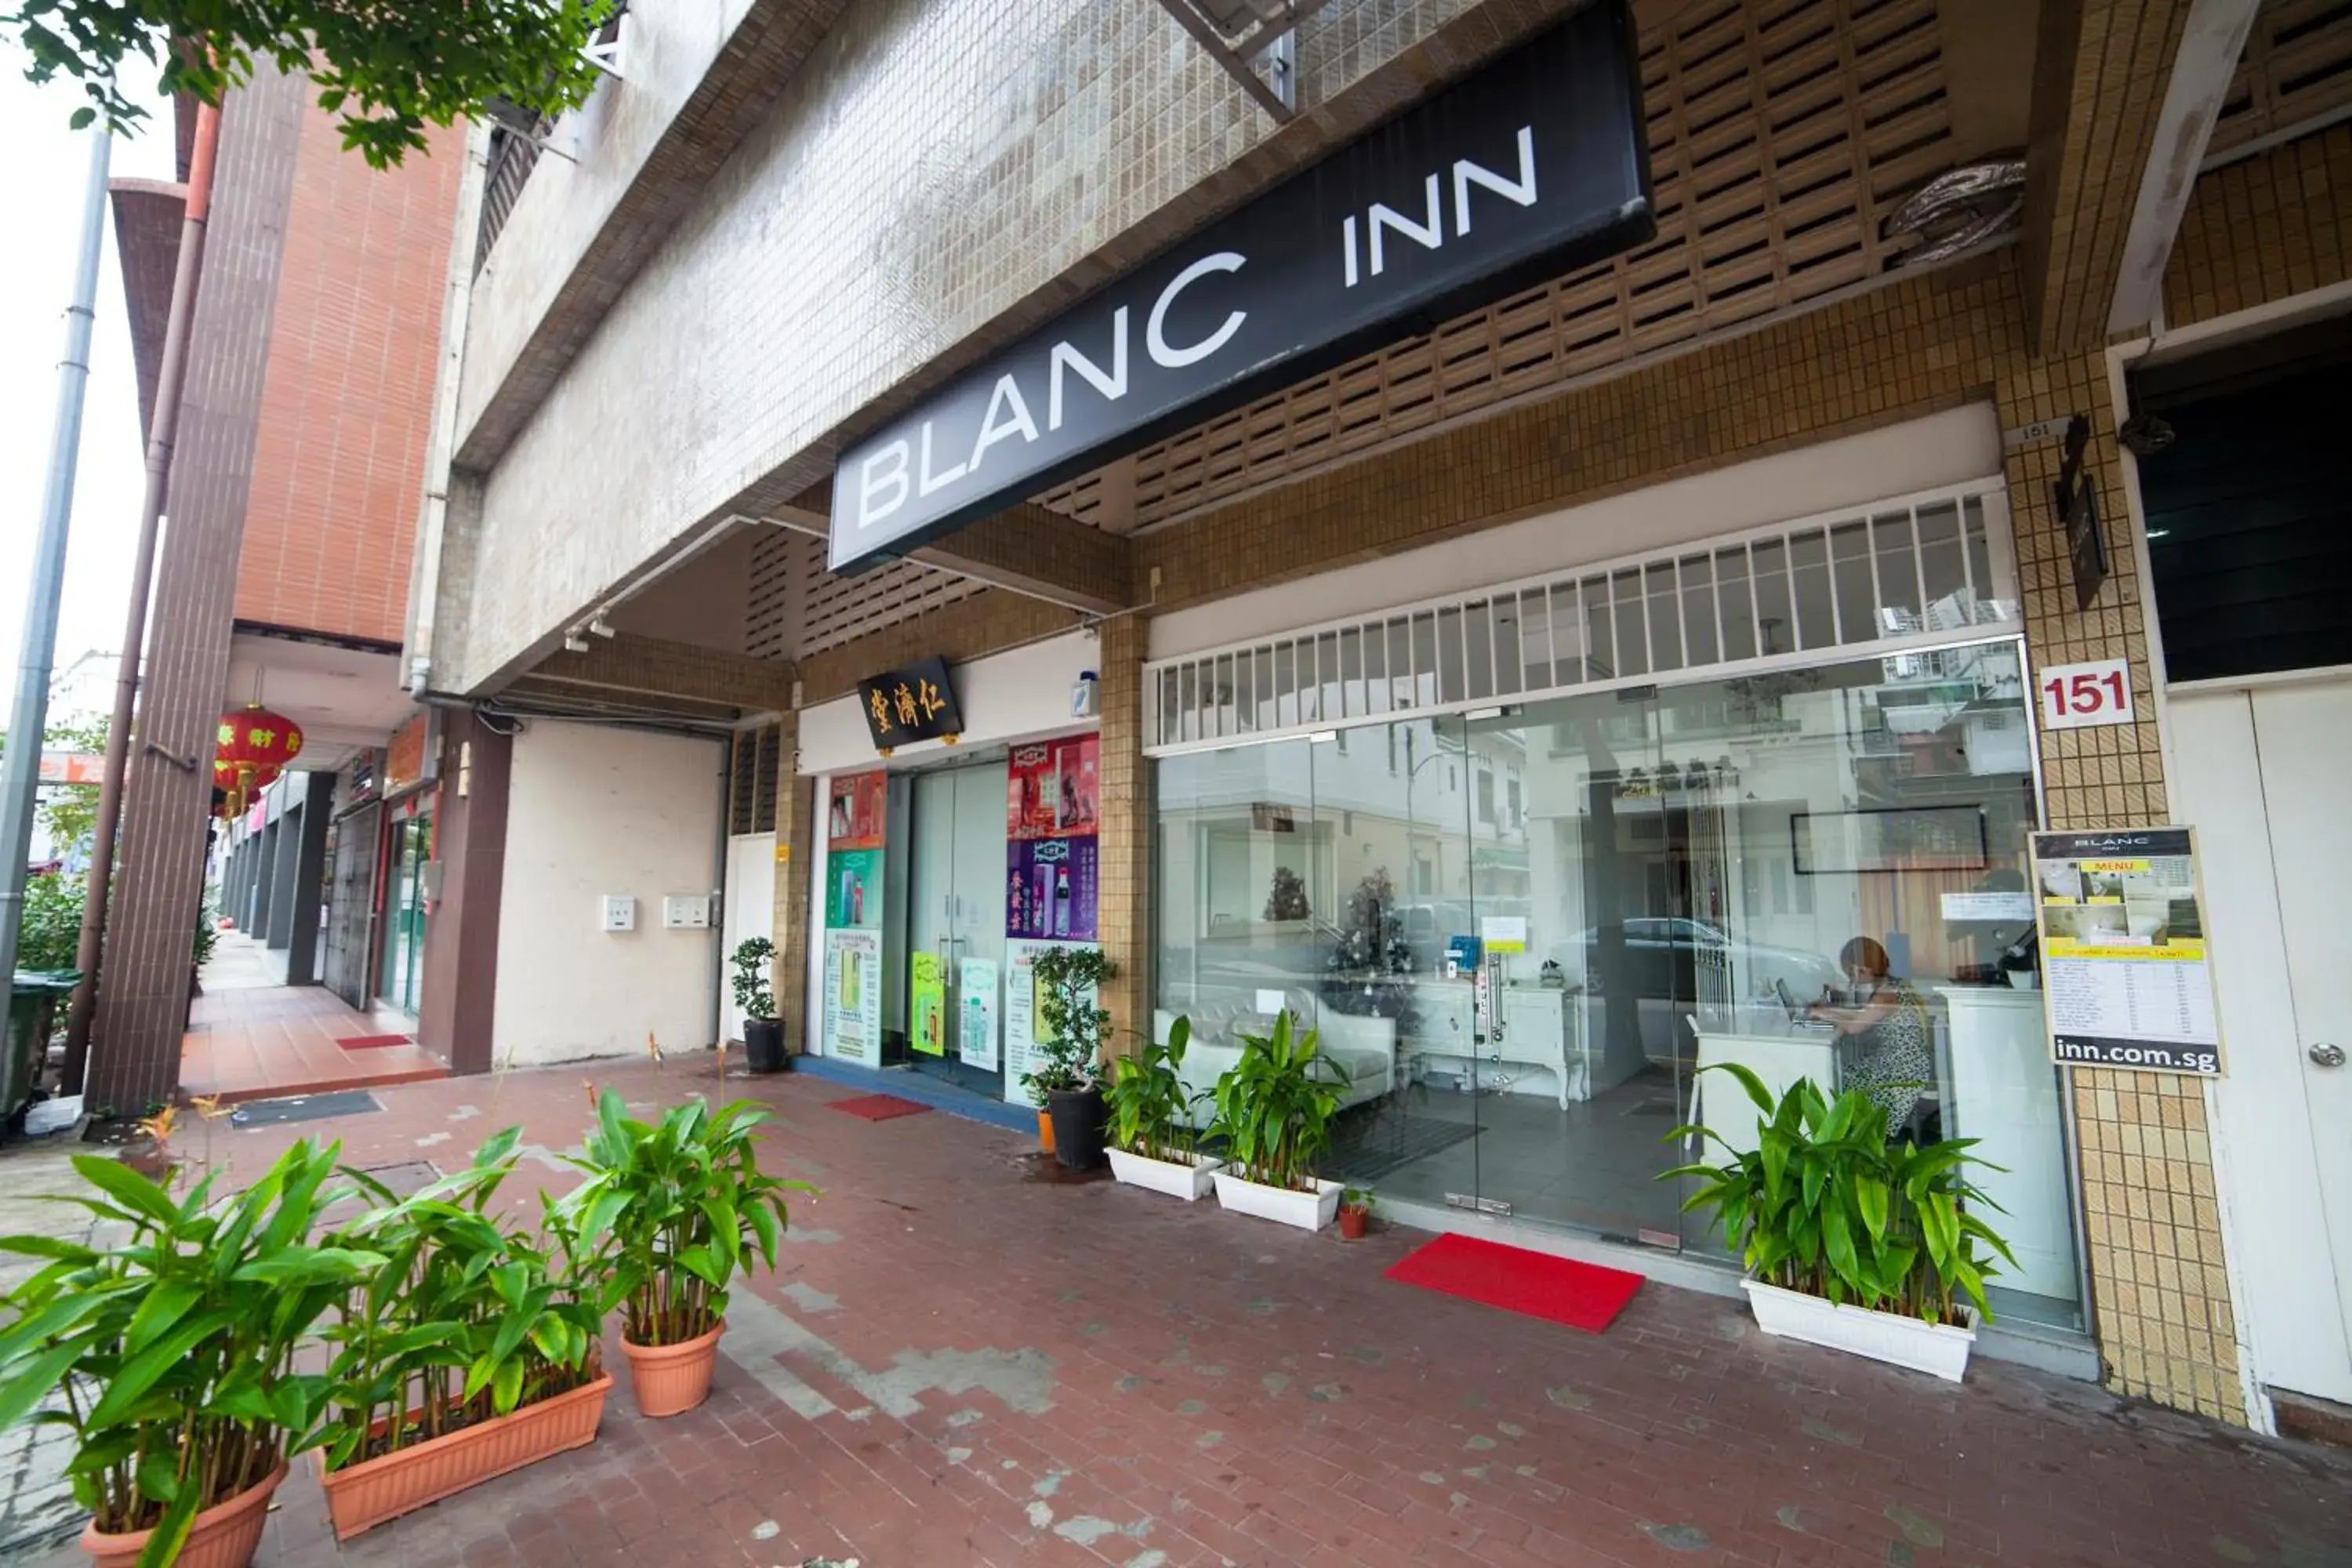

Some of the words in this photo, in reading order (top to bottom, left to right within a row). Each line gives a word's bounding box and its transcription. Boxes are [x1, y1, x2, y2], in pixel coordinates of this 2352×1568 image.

[857, 252, 1247, 530] BLANC
[1343, 125, 1537, 288] INN
[2024, 423, 2049, 439] 151
[2044, 670, 2125, 716] 151
[2074, 837, 2149, 848] BLANC
[2094, 861, 2134, 870] MENU
[2057, 1039, 2216, 1073] inn.com.sg
